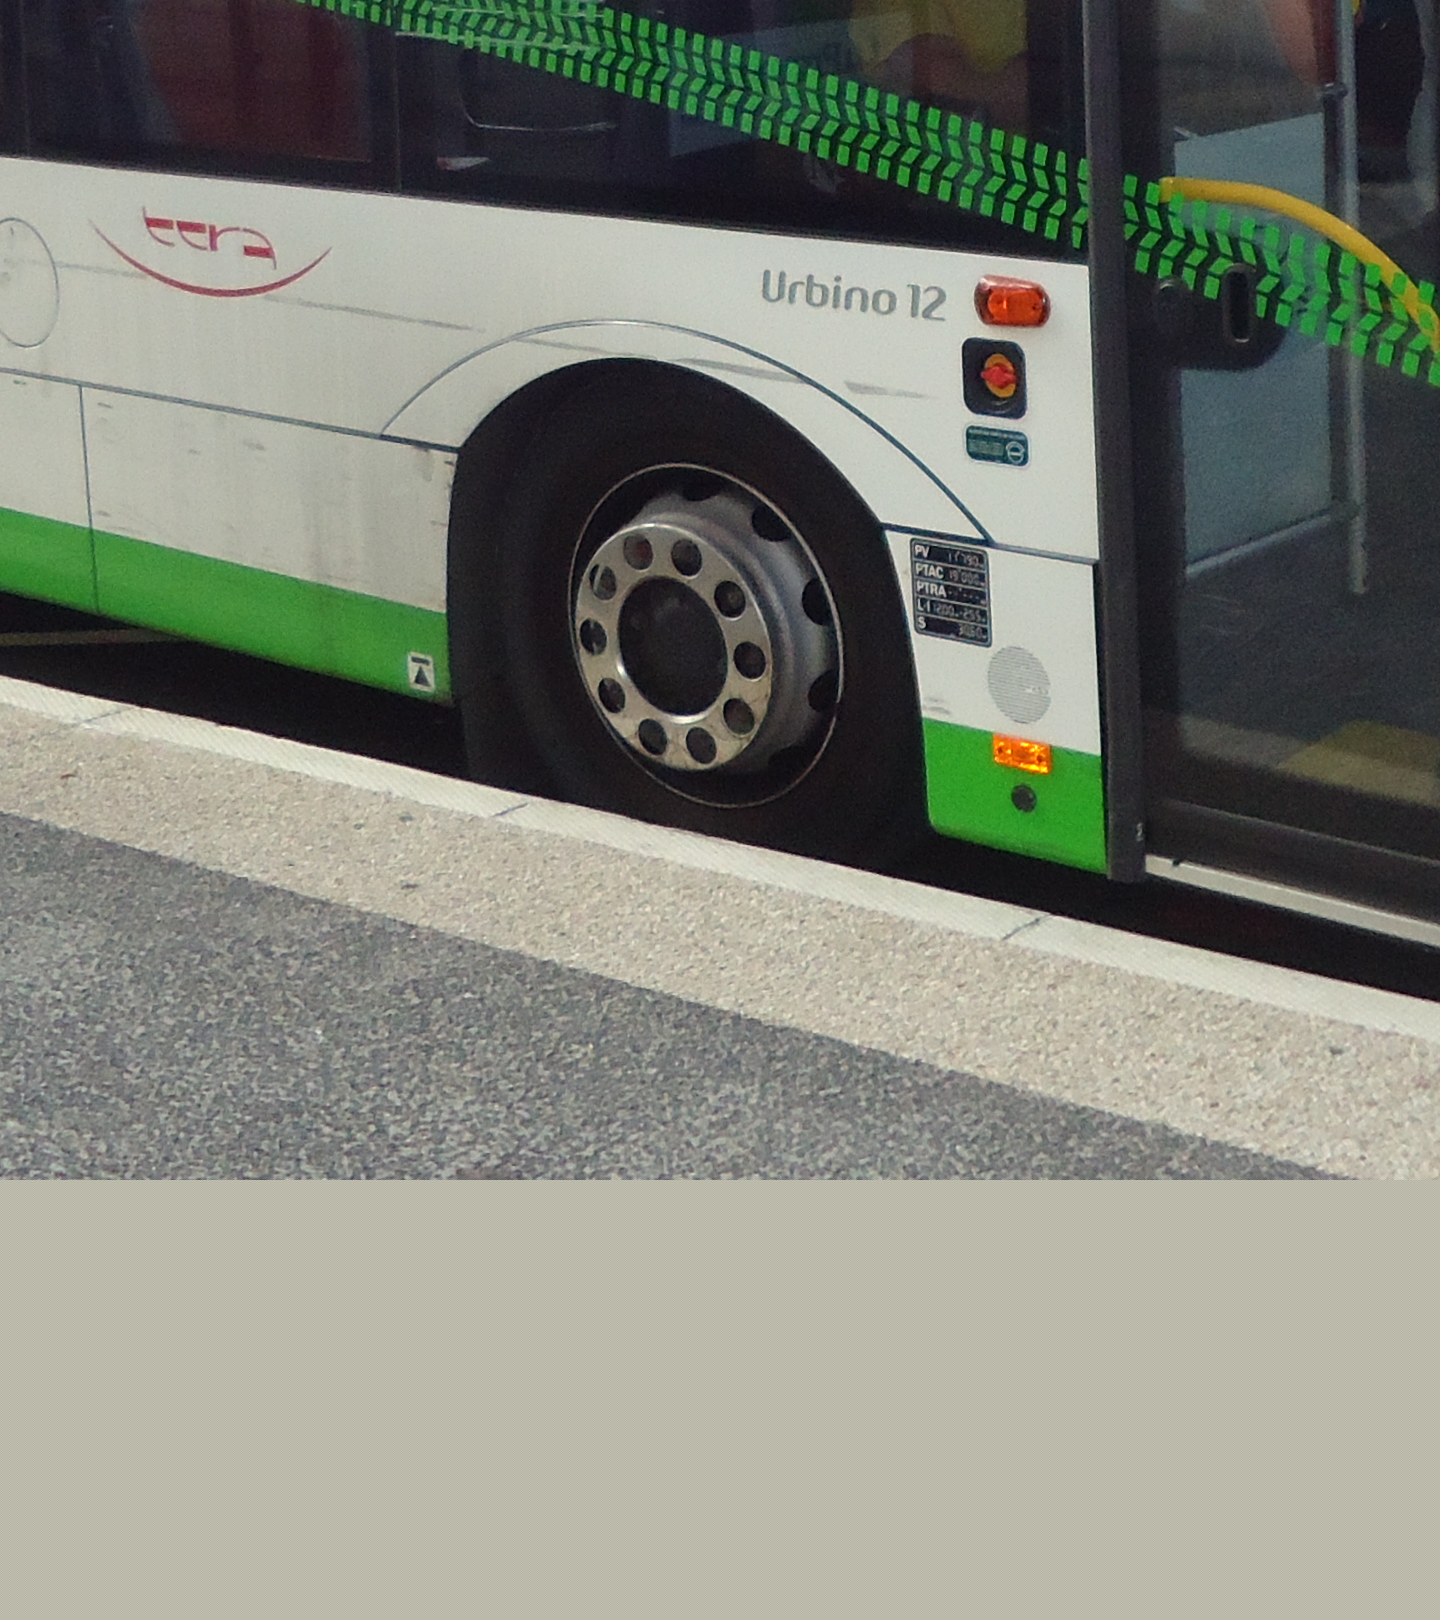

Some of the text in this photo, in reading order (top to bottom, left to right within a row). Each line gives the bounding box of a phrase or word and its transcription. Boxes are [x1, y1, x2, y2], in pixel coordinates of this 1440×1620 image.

[762, 269, 947, 322] Urbino 12
[914, 544, 930, 558] PV
[915, 562, 945, 579] PTAC
[916, 581, 947, 598] PTRA
